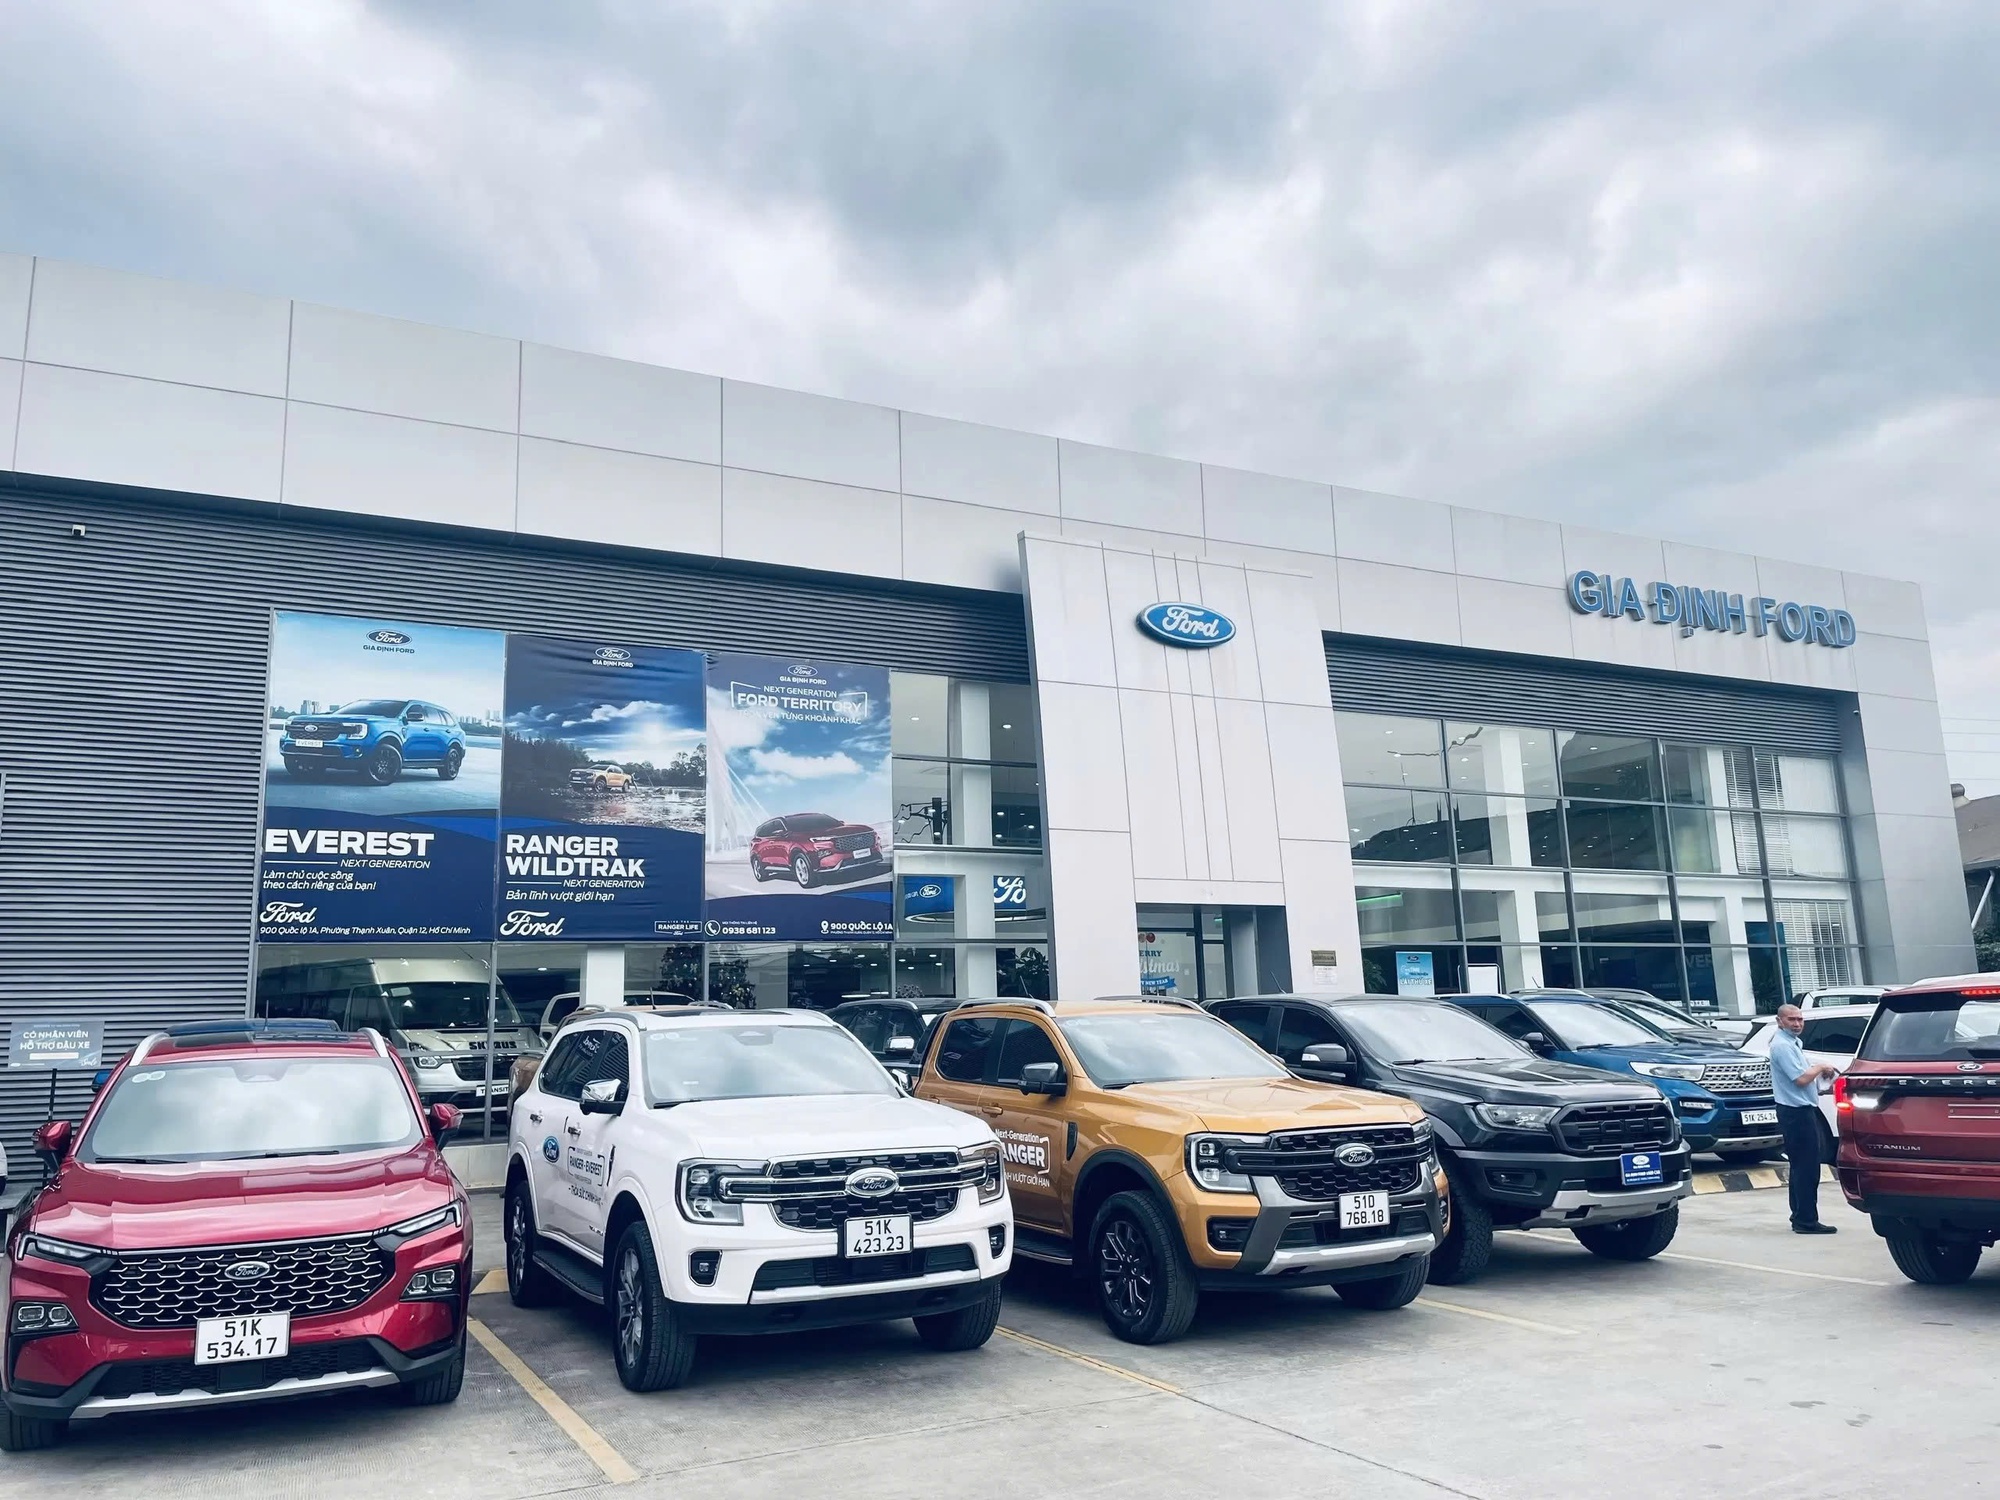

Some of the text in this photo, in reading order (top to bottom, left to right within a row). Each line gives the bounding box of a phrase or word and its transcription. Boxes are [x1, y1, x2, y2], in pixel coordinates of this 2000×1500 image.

[1568, 570, 1857, 648] GIA ĐỊNH FORD
[1162, 606, 1219, 637] Ford
[376, 631, 403, 643] Ford
[602, 648, 624, 658] Ford
[793, 666, 812, 675] Ford
[787, 687, 837, 698] GENERATION
[737, 693, 862, 713] FORD TERRITORY
[265, 829, 435, 857] EVEREST
[506, 834, 619, 856] RANGER
[340, 859, 431, 869] NEXT GENERATION
[505, 856, 645, 878] WILDTRAK
[263, 870, 285, 879] Làm
[286, 870, 305, 879] chủ
[306, 871, 329, 880] cuộc
[262, 880, 377, 891] theo cách riêng của bạn!
[563, 880, 645, 889] NEXT GENERATION
[994, 876, 1027, 904] Fo
[506, 890, 527, 900] Bản
[550, 891, 573, 902] vượt
[595, 892, 615, 902] hạn
[922, 886, 937, 896] Ford
[260, 901, 317, 923] Ford
[499, 910, 565, 936] Ford
[830, 922, 848, 930] 900
[872, 921, 884, 932] LỘ
[722, 926, 776, 935] 0938 681 123
[38, 1030, 65, 1039] NHÂN
[67, 1030, 89, 1038] VIÊN
[78, 1041, 90, 1049] XE
[469, 1041, 517, 1050] SKBUS
[480, 1086, 508, 1094] TNSIT
[1002, 1142, 1046, 1168] ANGER
[1348, 1151, 1367, 1163] Ford
[862, 1177, 888, 1190] Ford
[1039, 1177, 1050, 1188] HẠN
[1353, 1195, 1375, 1209] 51D
[1346, 1209, 1384, 1226] 768.18
[864, 1219, 892, 1236] 51K
[853, 1236, 904, 1254] 423.23
[235, 1265, 260, 1276] Ford
[224, 1319, 262, 1338] 51K
[207, 1337, 277, 1359] 534.17
